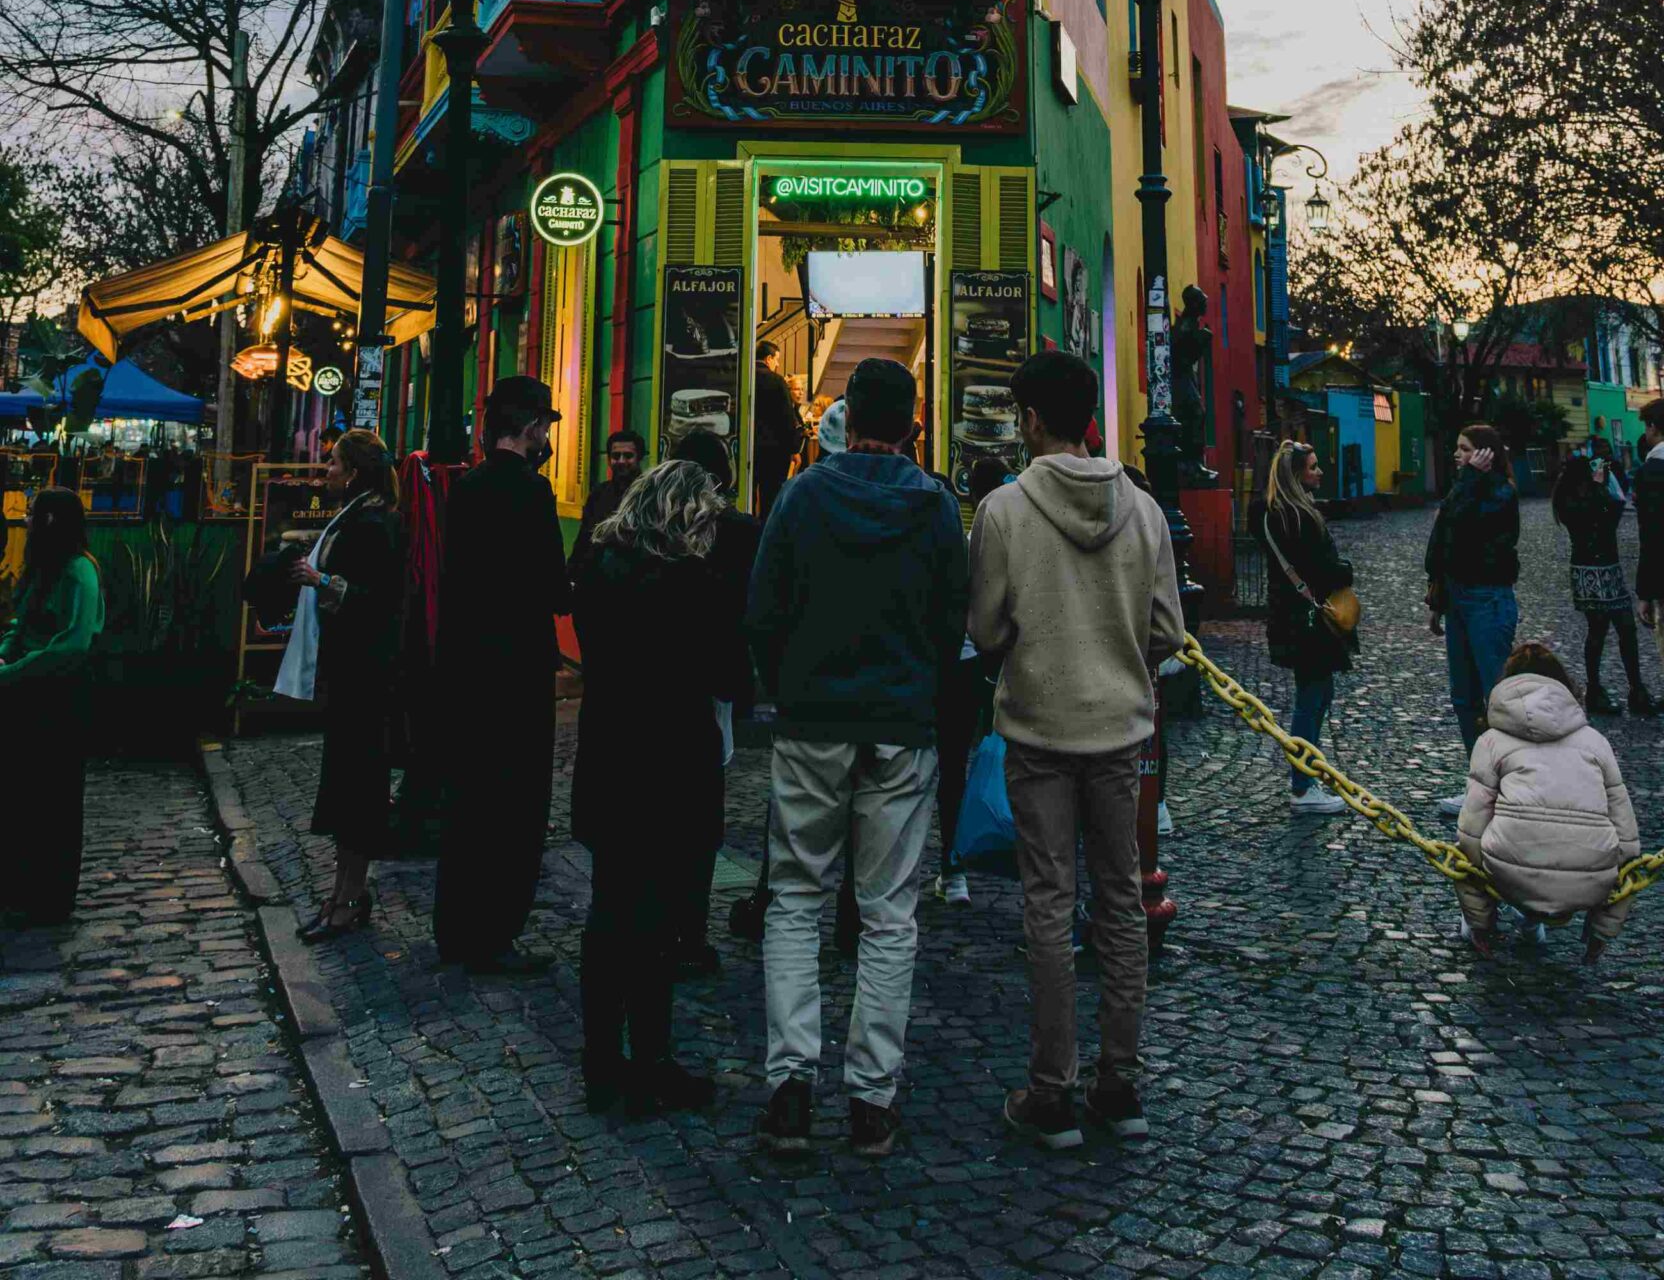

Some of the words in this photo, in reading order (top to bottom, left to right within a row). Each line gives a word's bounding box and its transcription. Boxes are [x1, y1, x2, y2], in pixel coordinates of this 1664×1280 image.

[736, 46, 962, 101] CAMINITO
[790, 101, 852, 111] BUENOS
[859, 101, 905, 112] AIRES
[776, 177, 924, 197] @VISITCAMINITO
[672, 280, 736, 293] ALFAJOR
[959, 285, 1023, 298] ALFAJOR
